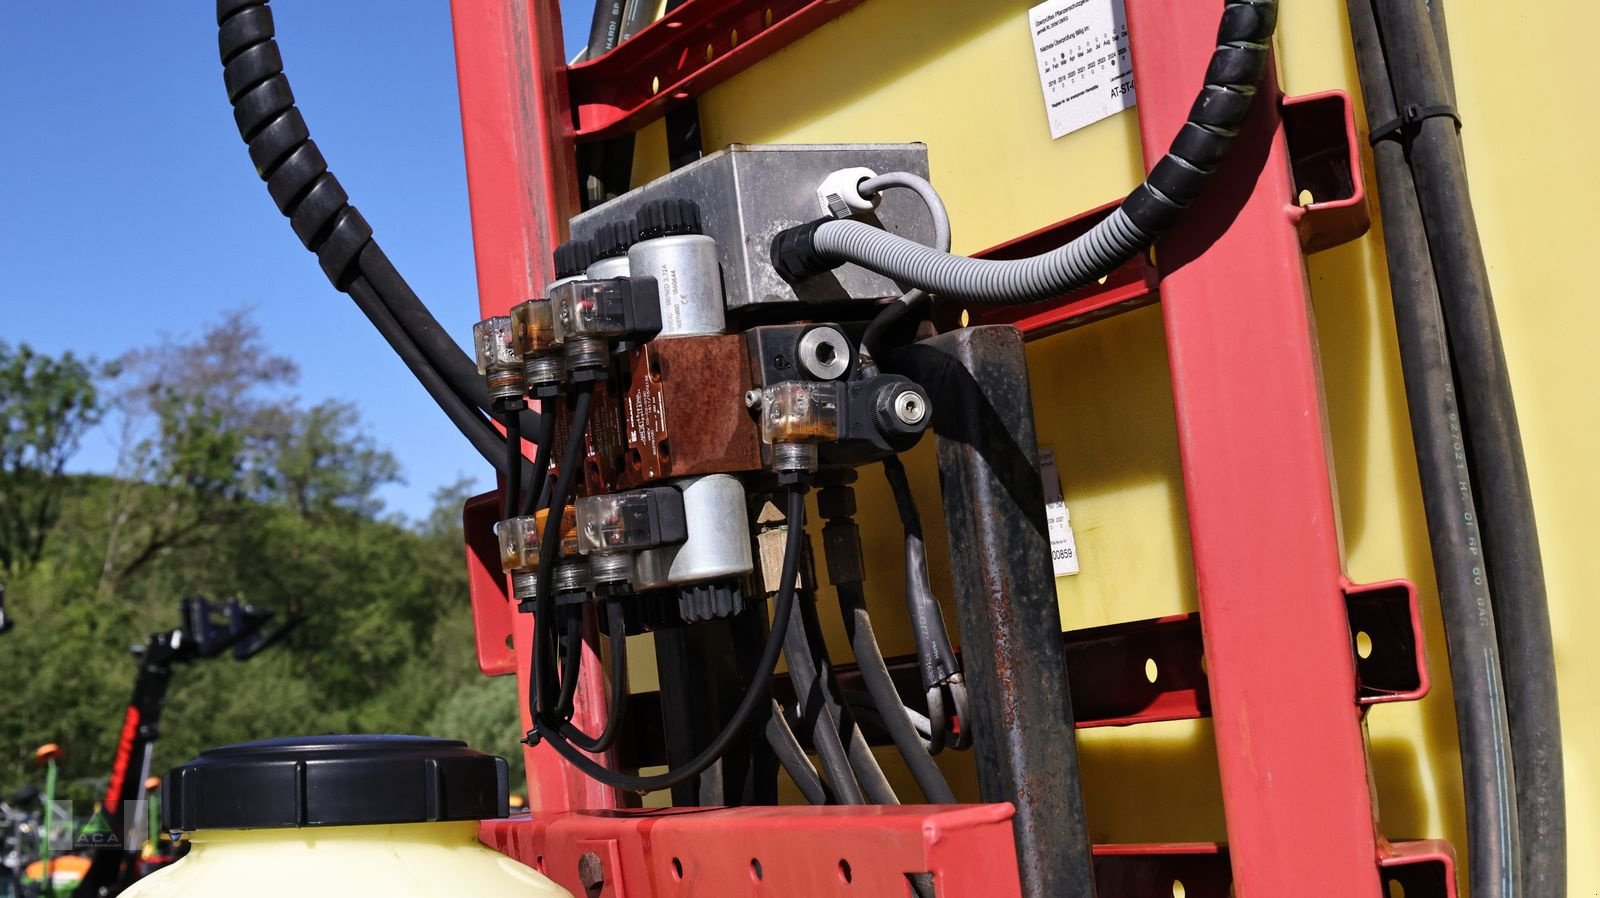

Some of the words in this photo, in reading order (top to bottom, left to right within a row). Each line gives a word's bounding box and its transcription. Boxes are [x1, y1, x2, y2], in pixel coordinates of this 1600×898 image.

[606, 21, 616, 50] HARDI
[1054, 32, 1076, 46] Überprüfung
[1077, 66, 1085, 74] 2021
[1087, 61, 1096, 70] 2022
[1097, 57, 1106, 65] 2023
[1107, 52, 1116, 60] 2024
[1448, 413, 1462, 469] 927021
[1473, 568, 1482, 586] 60
